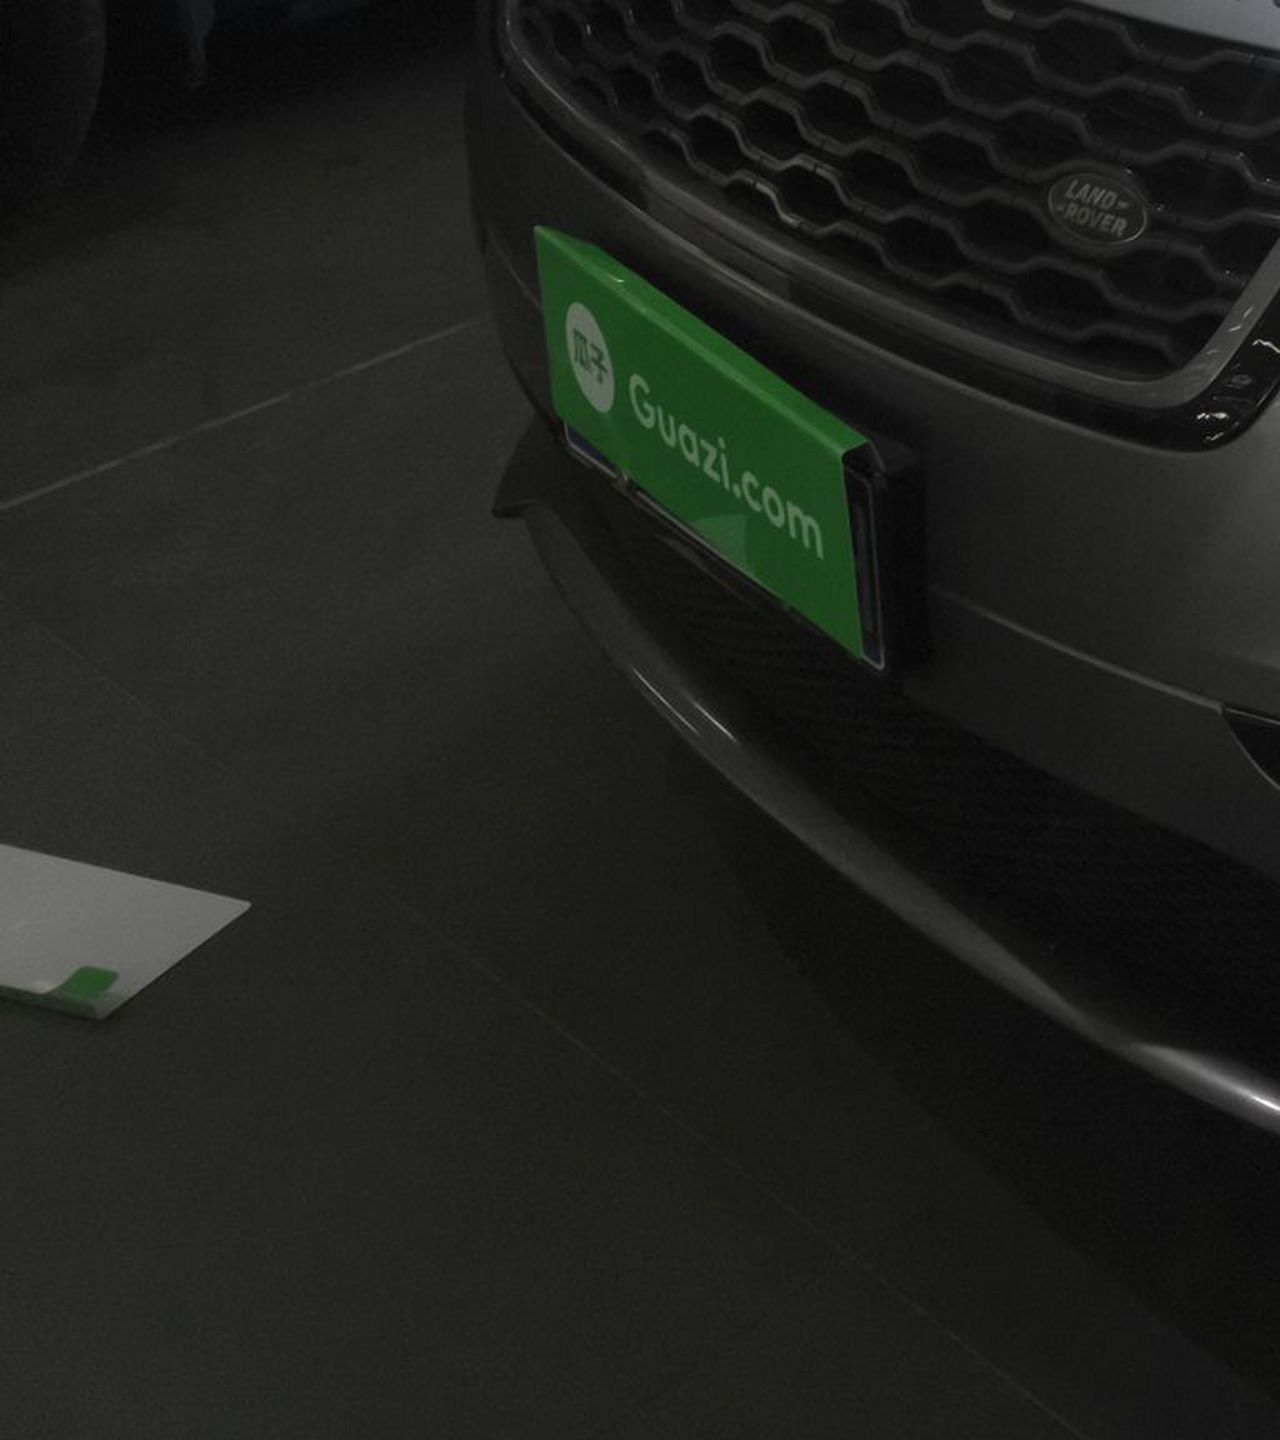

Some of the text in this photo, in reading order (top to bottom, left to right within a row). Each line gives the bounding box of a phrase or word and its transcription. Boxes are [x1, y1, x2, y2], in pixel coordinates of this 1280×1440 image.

[1064, 179, 1118, 210] LAND
[1063, 202, 1128, 237] ROVER
[572, 328, 609, 385] 瓜子
[628, 373, 825, 559] Guazi.com
